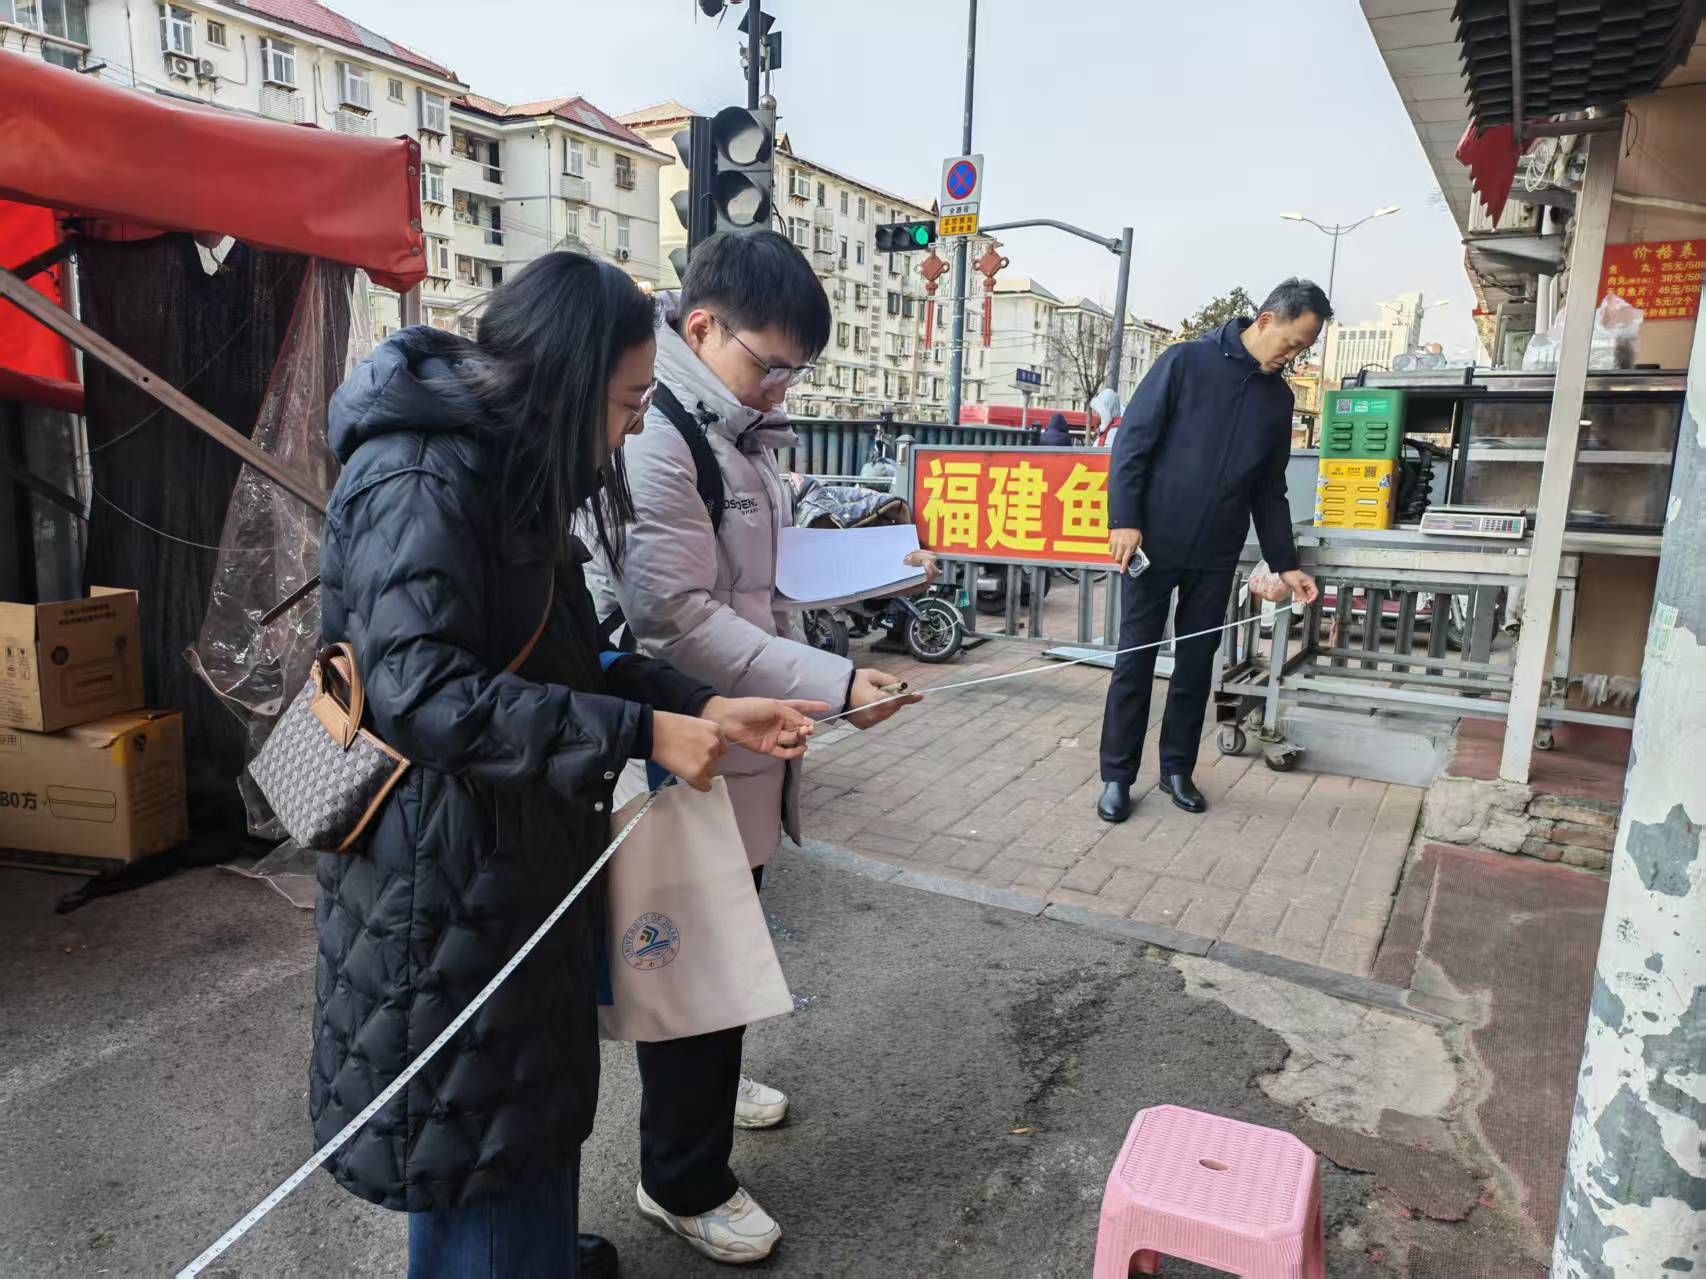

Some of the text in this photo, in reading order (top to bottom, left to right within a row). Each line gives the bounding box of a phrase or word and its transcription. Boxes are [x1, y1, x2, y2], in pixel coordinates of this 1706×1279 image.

[1633, 241, 1696, 260] 价格表
[922, 458, 1111, 555] 福建鱼
